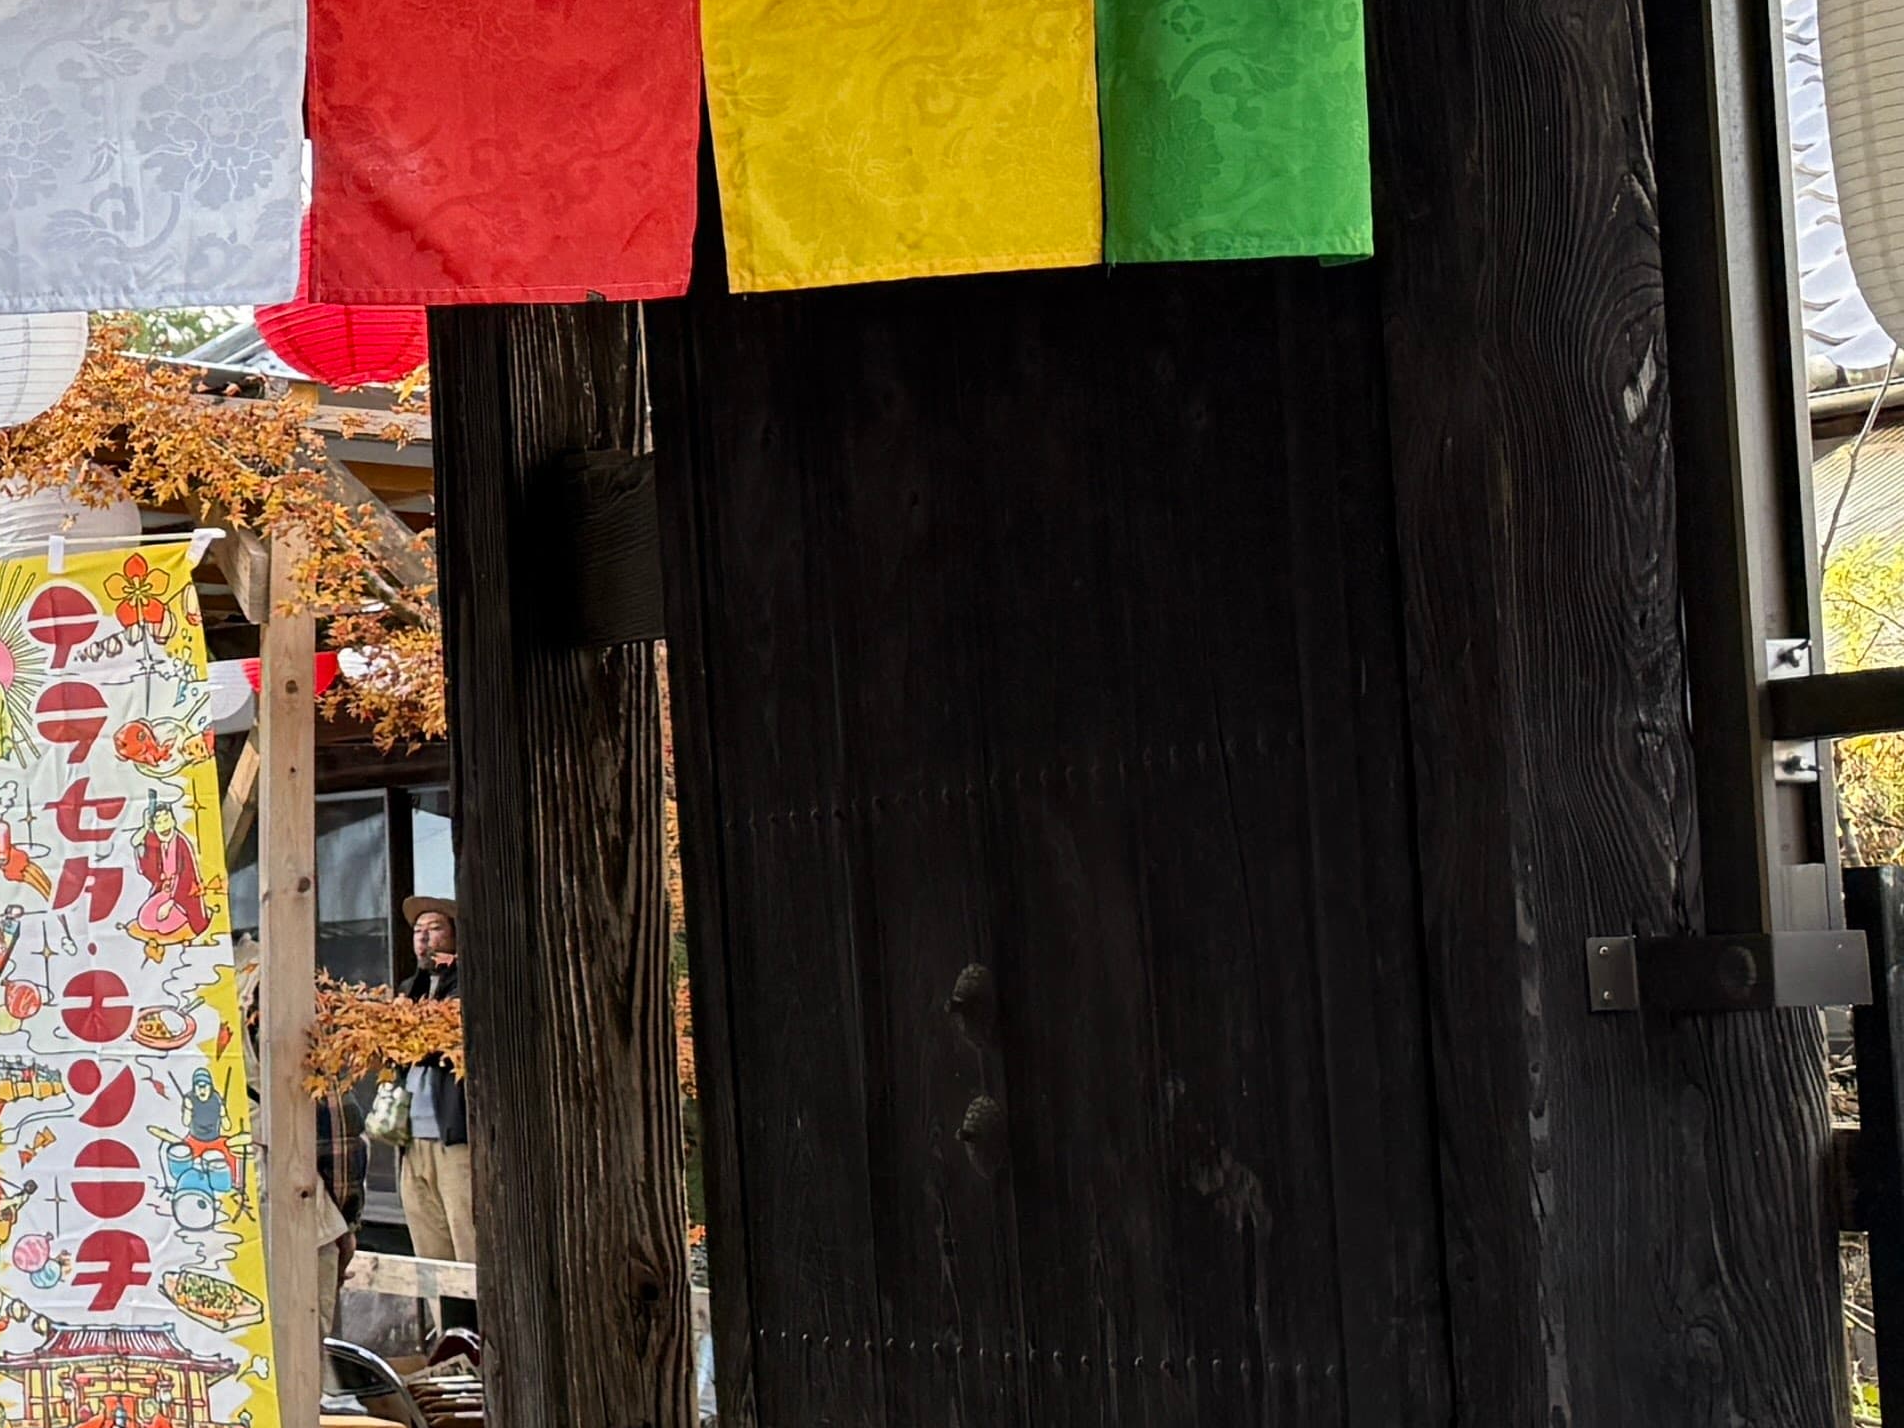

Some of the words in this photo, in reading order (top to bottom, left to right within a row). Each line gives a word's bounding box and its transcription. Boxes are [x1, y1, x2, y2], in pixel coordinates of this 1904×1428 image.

[26, 584, 152, 1313] テラセタ・エンニチ
